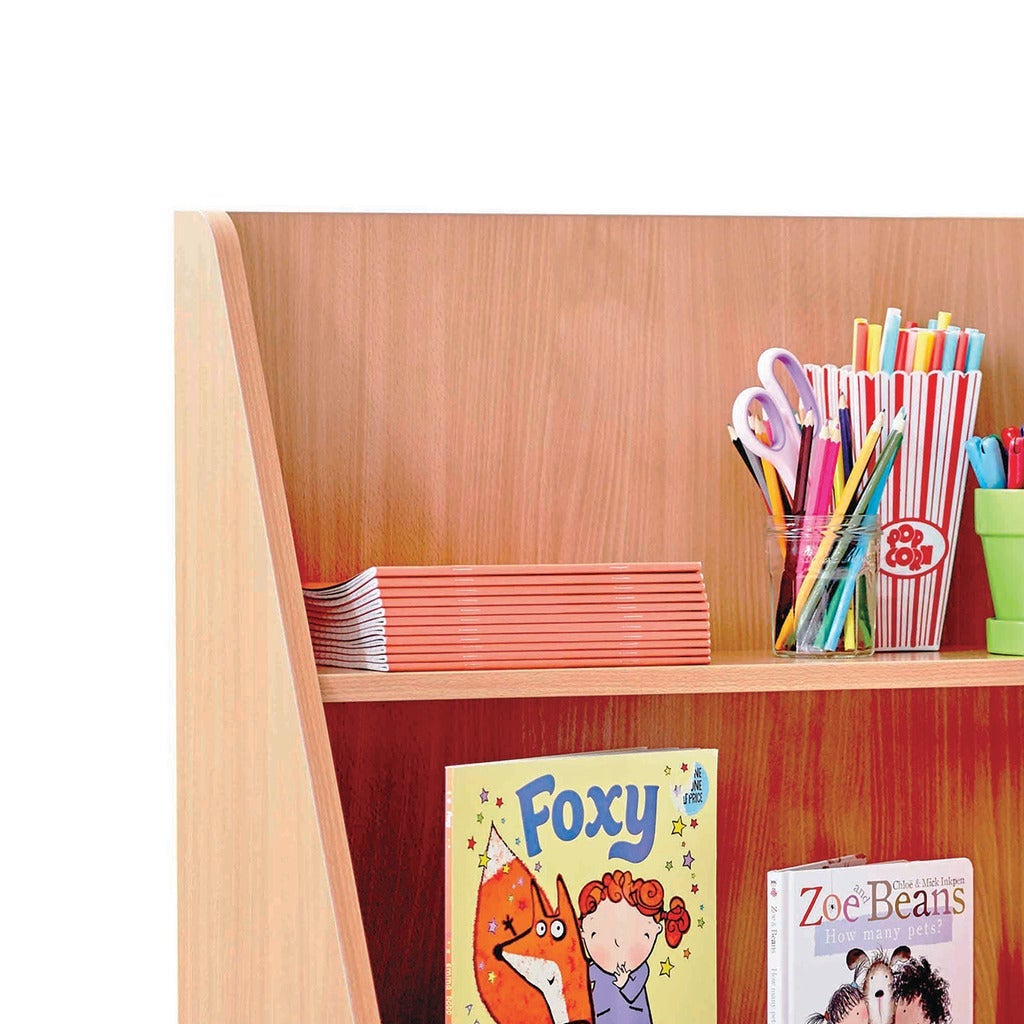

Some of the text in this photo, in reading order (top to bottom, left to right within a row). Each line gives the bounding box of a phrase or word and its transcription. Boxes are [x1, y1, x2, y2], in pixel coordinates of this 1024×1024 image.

[887, 524, 924, 549] POP
[886, 547, 933, 571] CORN
[515, 774, 660, 864] Foxy
[914, 878, 921, 888] &
[921, 877, 939, 888] Mick
[940, 876, 965, 888] Inkpen
[799, 880, 966, 927] Zoe and Beans
[825, 919, 943, 944] How many pets?
[465, 1003, 473, 1016] A
